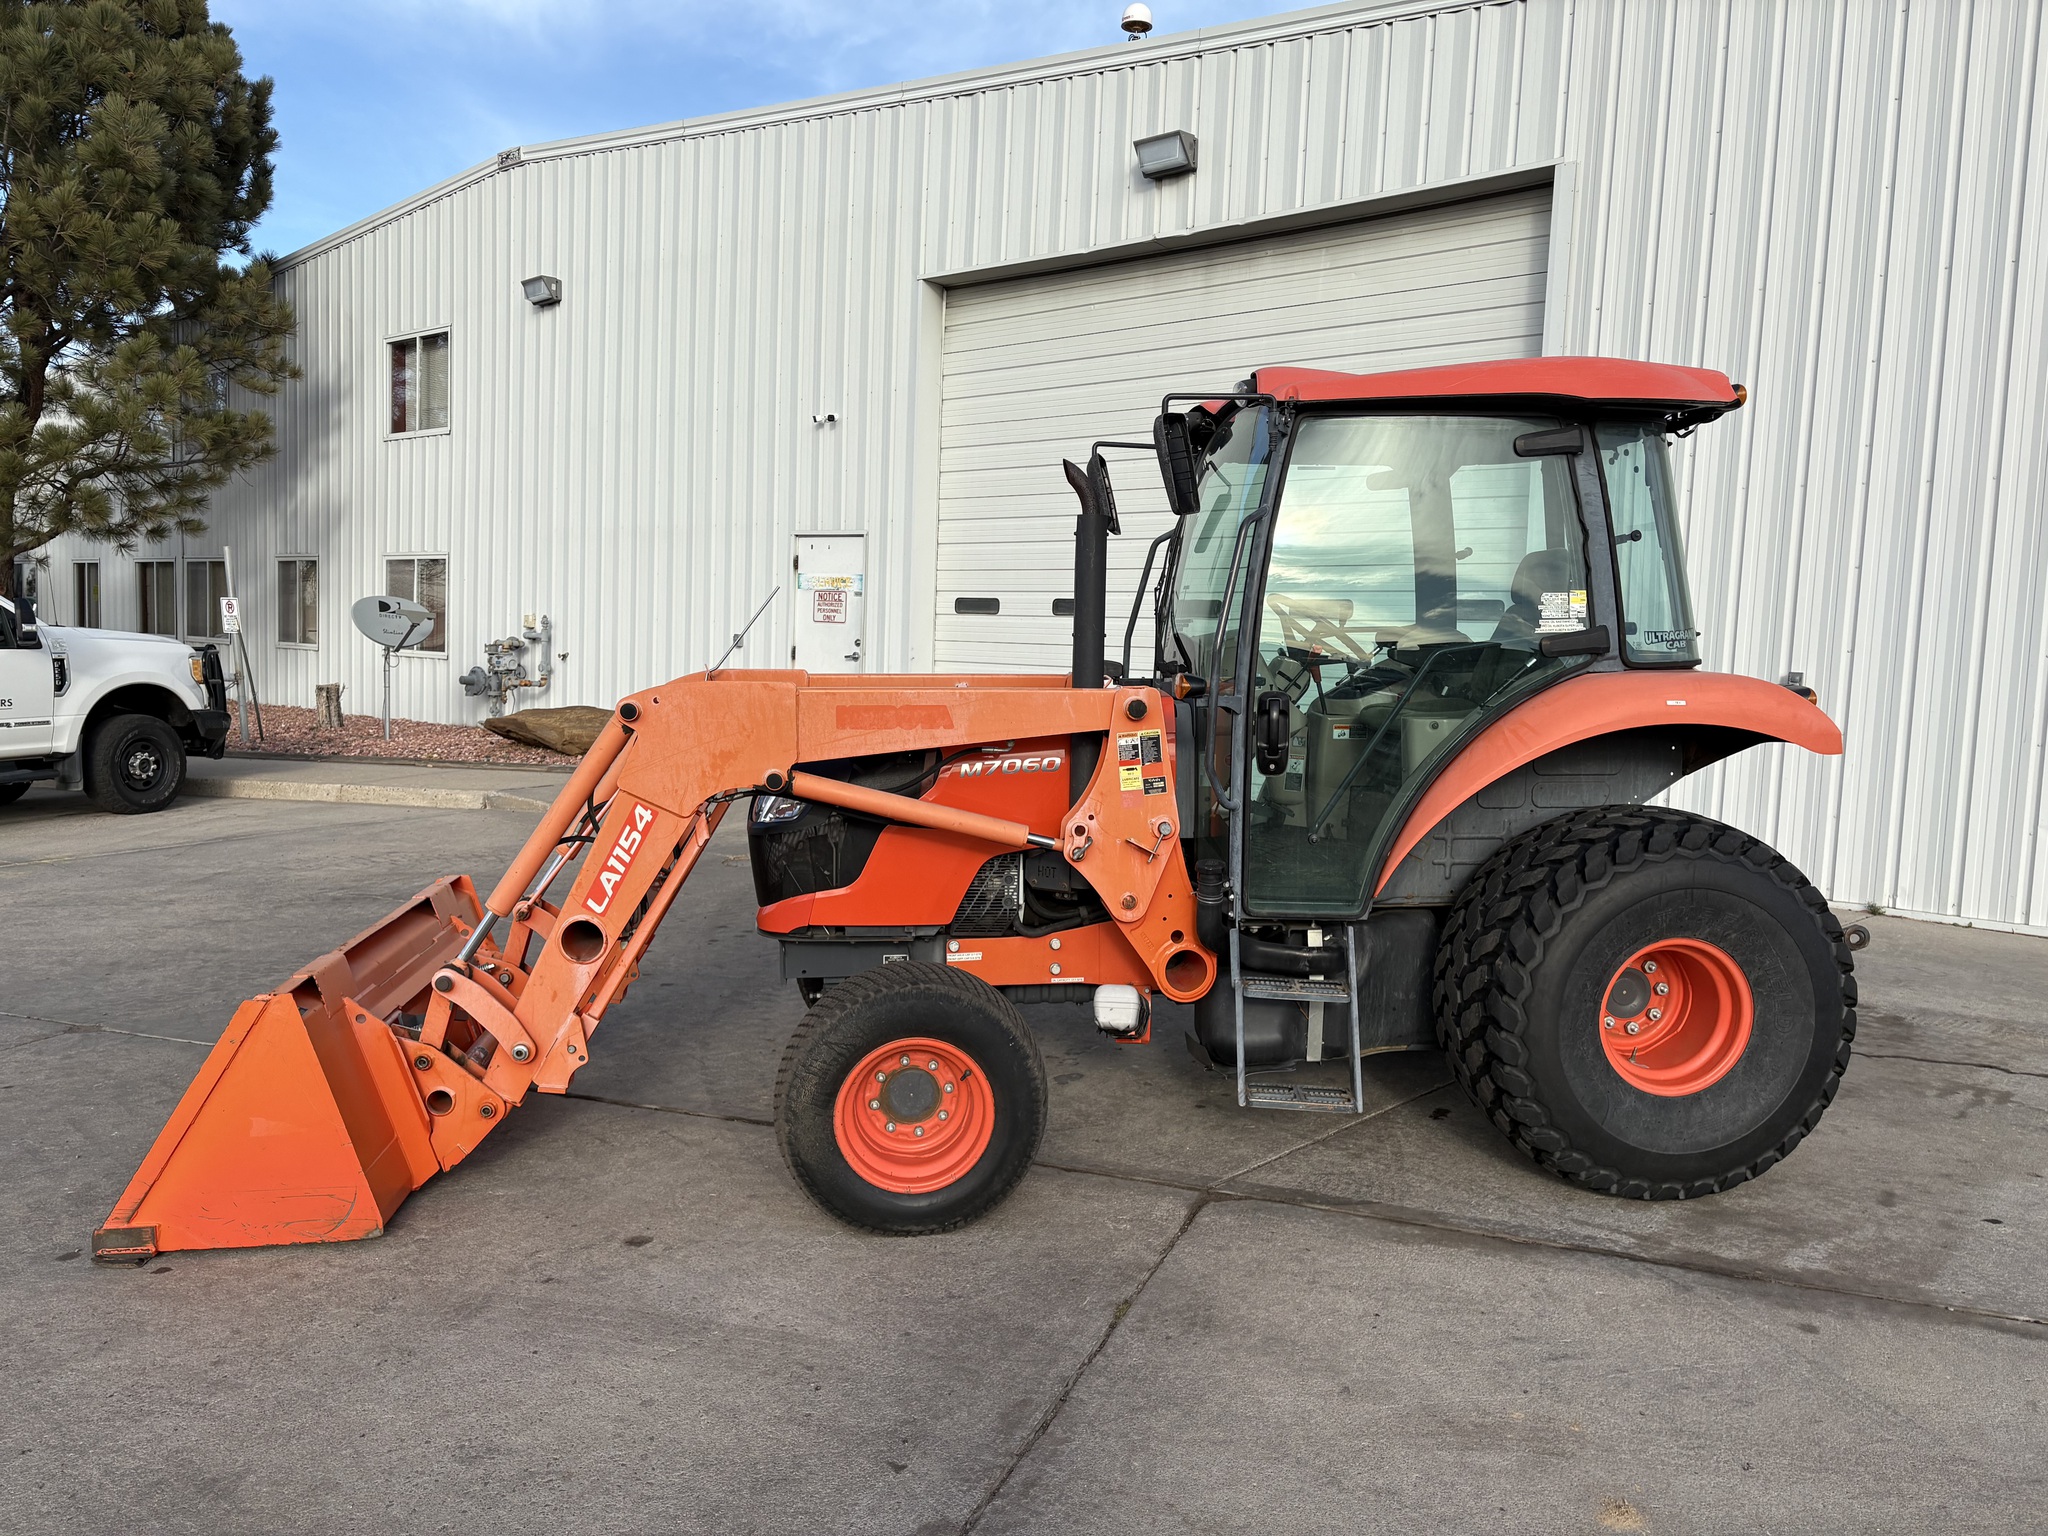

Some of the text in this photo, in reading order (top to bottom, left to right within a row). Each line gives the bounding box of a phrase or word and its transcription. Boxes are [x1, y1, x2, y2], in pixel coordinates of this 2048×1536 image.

[818, 592, 843, 601] NOTICE
[1645, 629, 1695, 644] ULTRAGRAN
[1666, 640, 1687, 650] CAB
[960, 757, 1062, 778] M7060
[586, 803, 654, 914] LA1154
[1037, 865, 1057, 879] HOT
